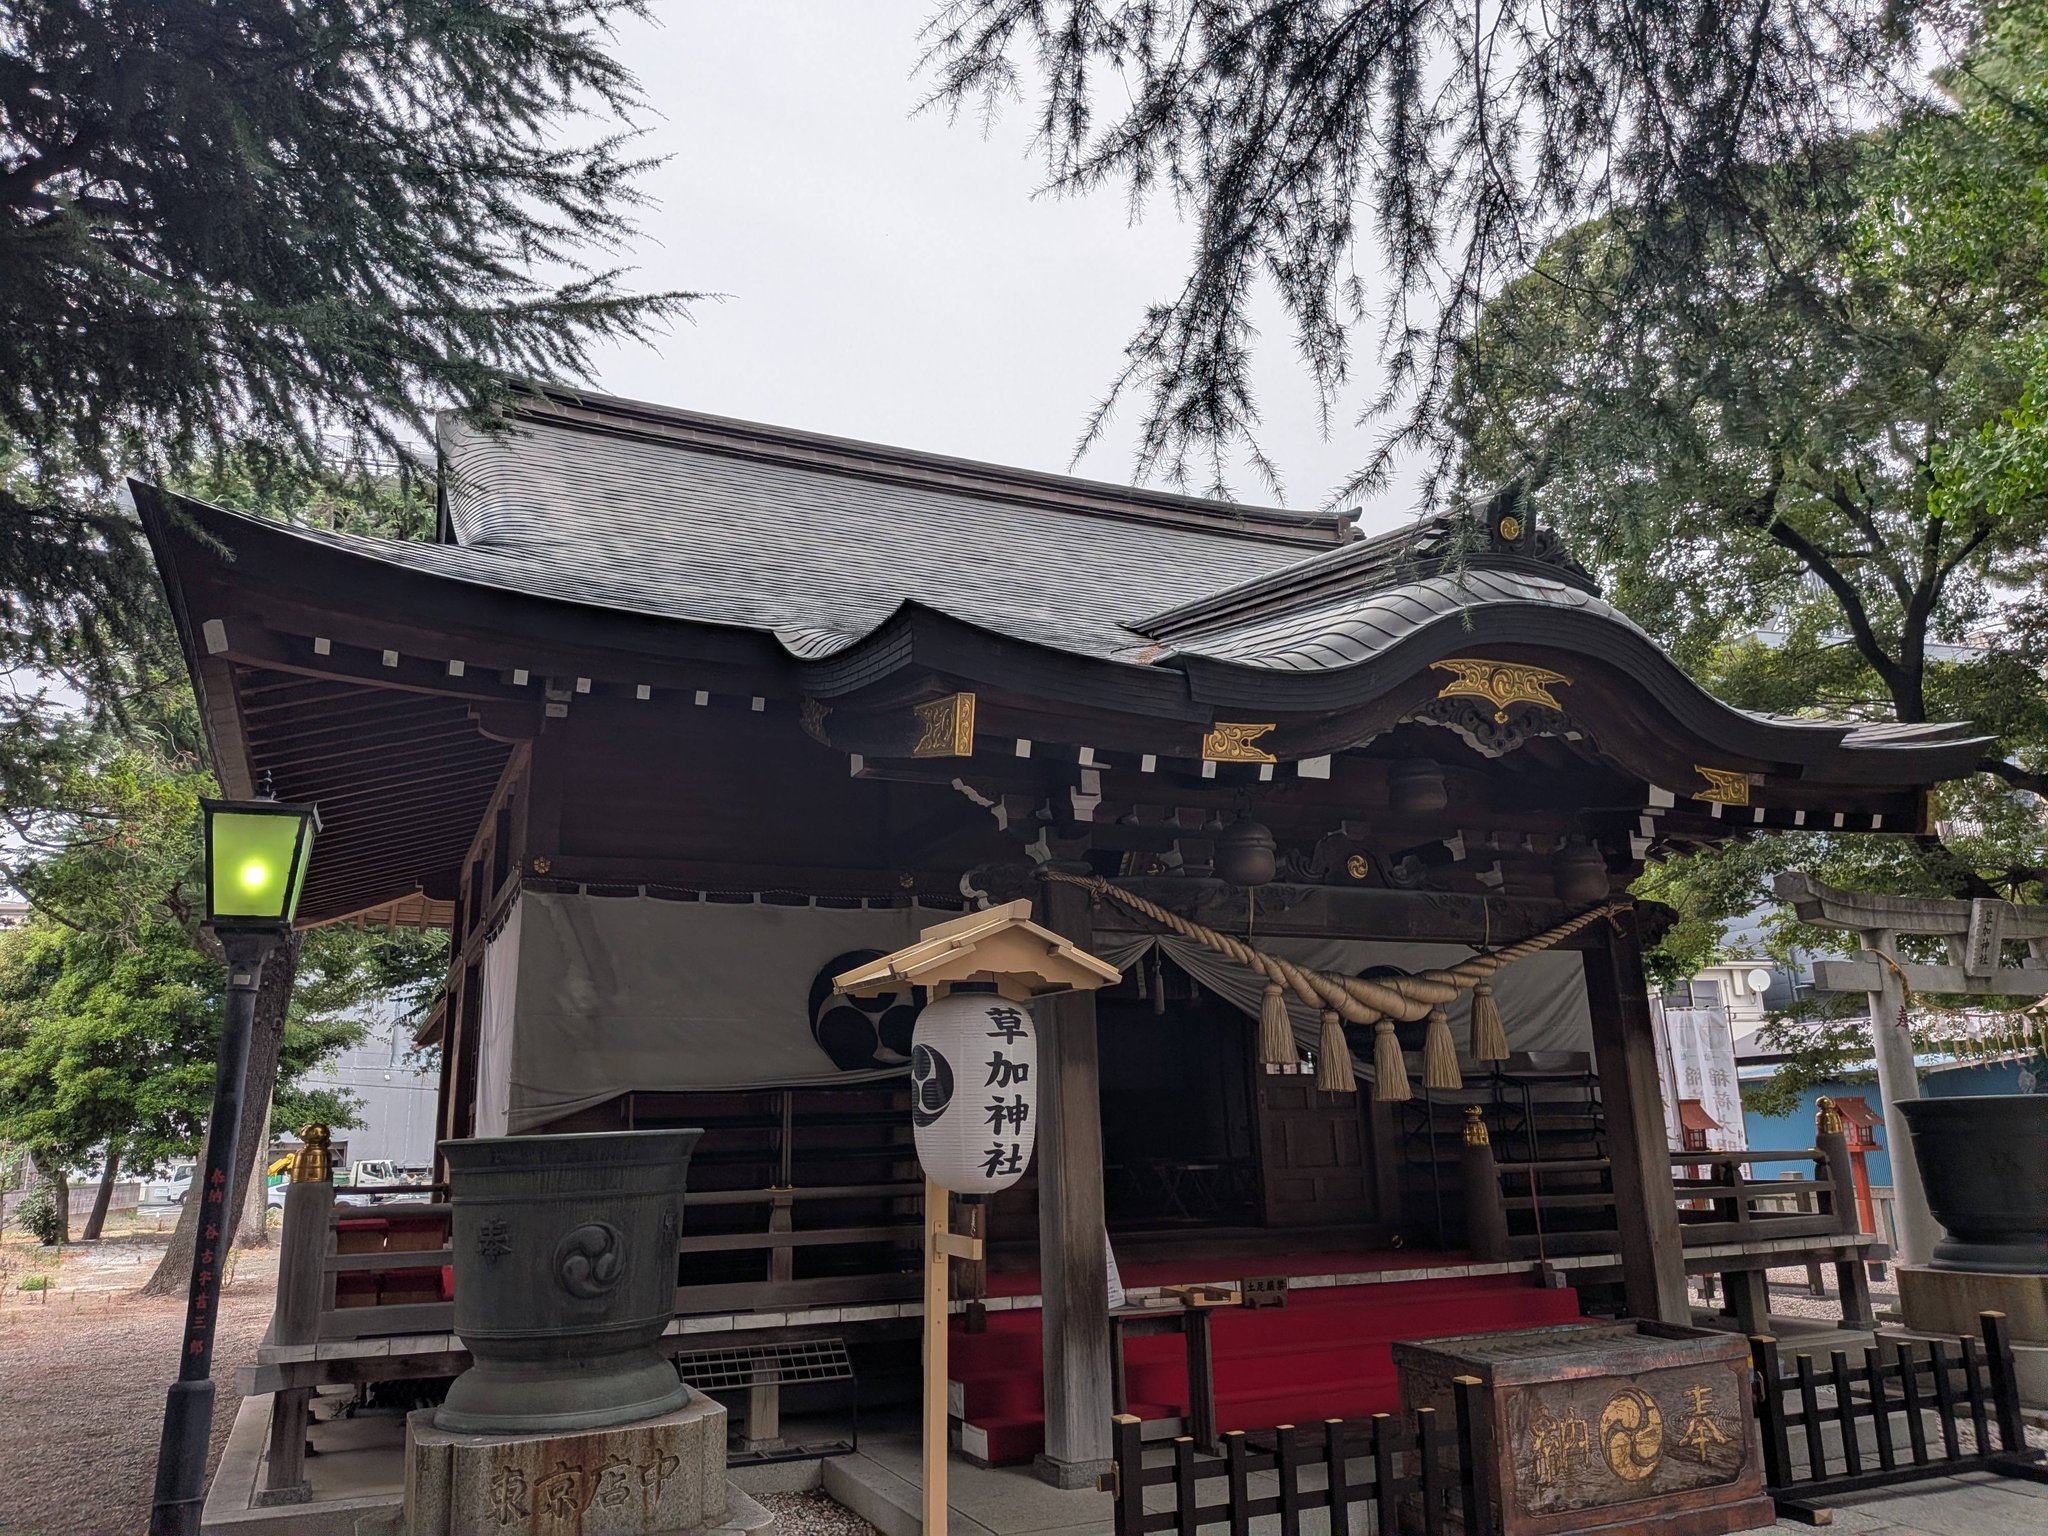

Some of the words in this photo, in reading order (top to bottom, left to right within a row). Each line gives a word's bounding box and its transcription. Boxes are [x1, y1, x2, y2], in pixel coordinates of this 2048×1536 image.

[1979, 908, 1993, 965] 草加神社
[978, 1007, 1030, 1178] 草加神社
[208, 1167, 225, 1203] 奉納
